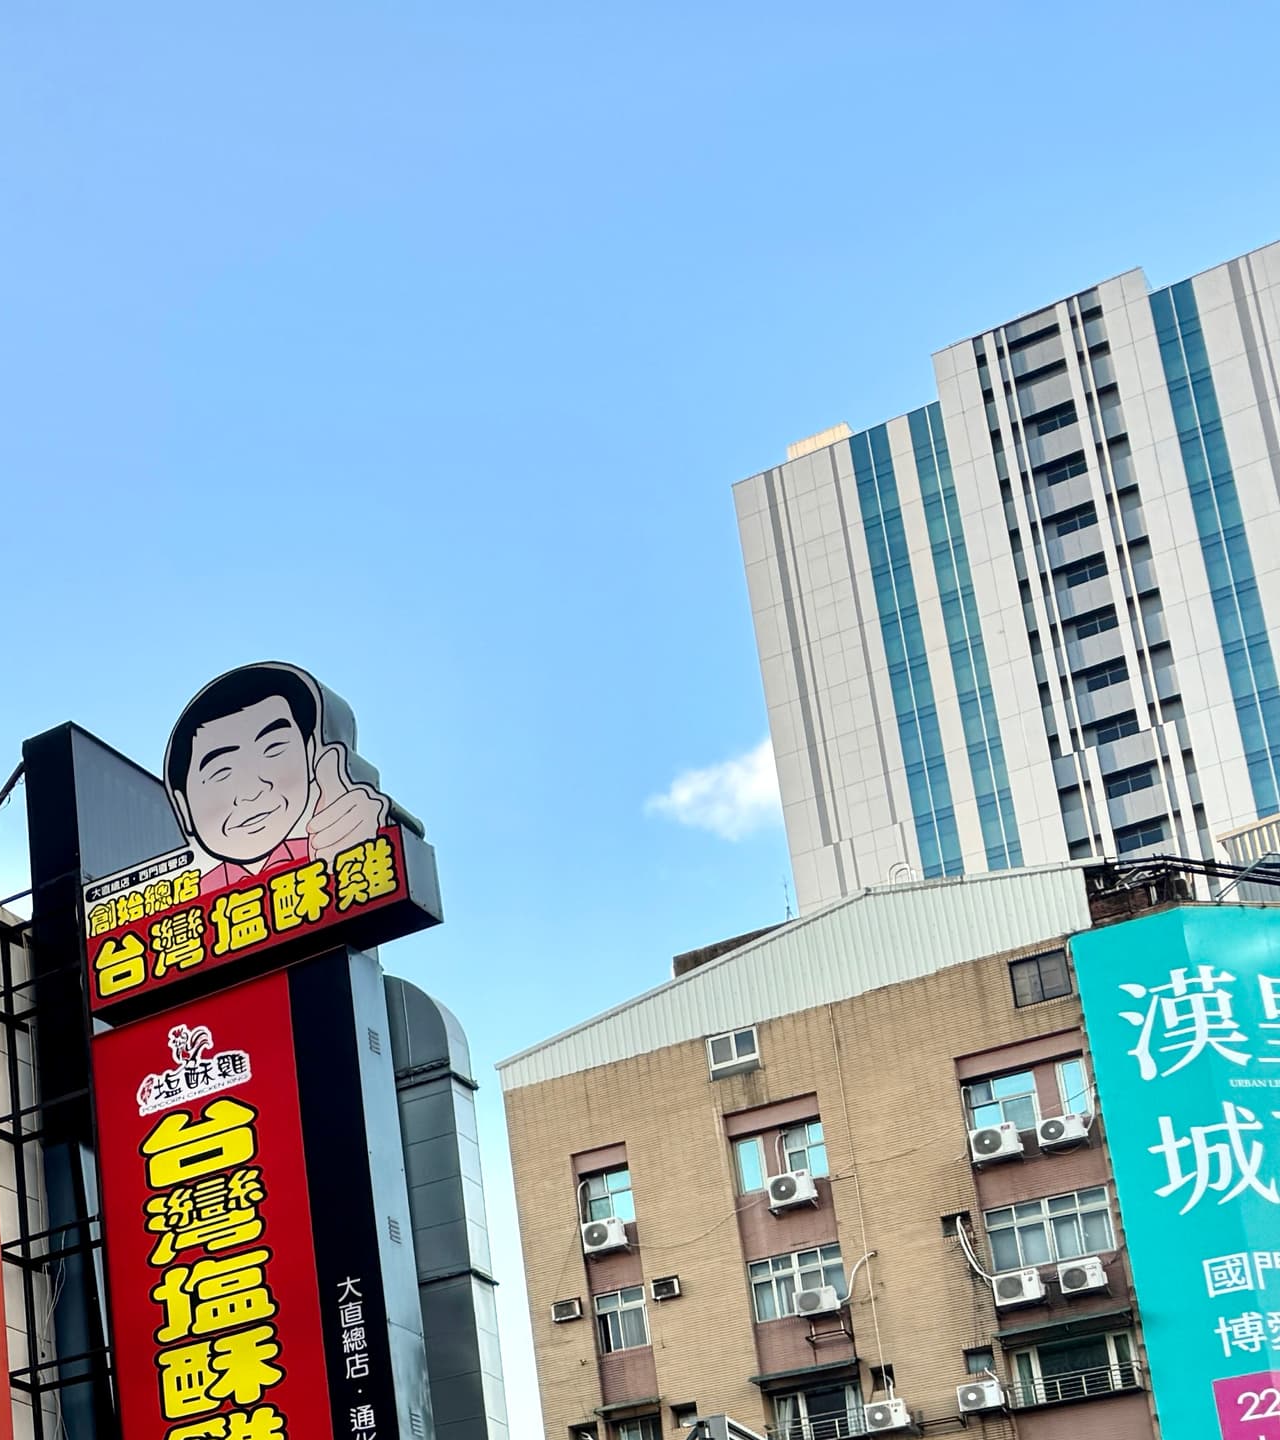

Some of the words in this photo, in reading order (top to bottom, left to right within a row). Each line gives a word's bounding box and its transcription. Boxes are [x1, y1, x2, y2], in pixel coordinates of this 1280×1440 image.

[89, 870, 201, 937] 創始總店
[95, 837, 398, 997] 台灣塩酥雞
[154, 1053, 248, 1100] 塩酥雞
[337, 1276, 369, 1380] 大直總店
